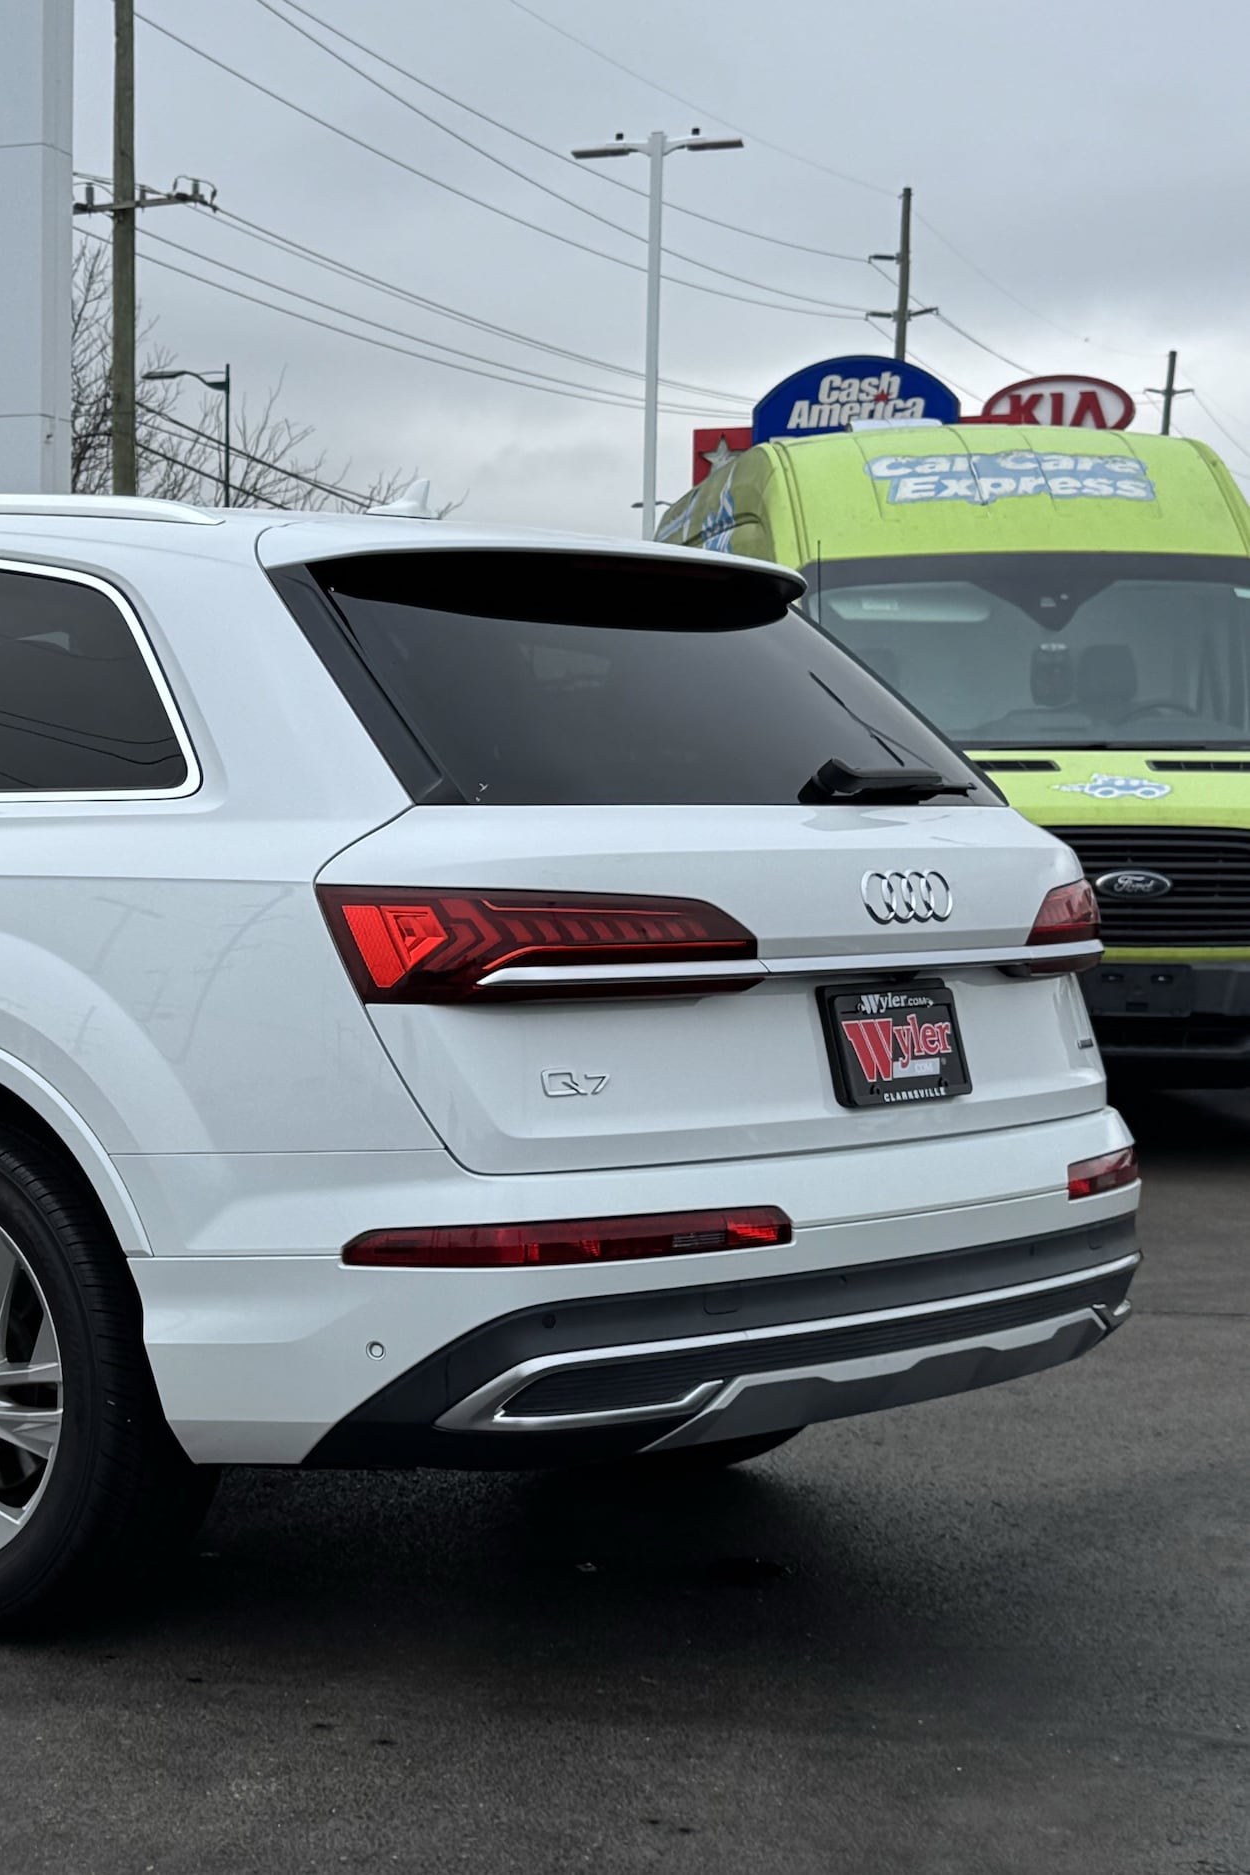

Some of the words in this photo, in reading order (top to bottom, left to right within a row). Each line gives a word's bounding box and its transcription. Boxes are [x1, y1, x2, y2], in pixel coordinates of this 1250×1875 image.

[818, 371, 901, 402] Cash
[786, 397, 926, 429] America
[1009, 391, 1108, 429] KIA
[871, 455, 979, 476] Car
[1002, 451, 1143, 474] Care
[895, 475, 1150, 503] Express
[1114, 875, 1155, 892] Ford
[841, 1014, 953, 1083] Wyler
[540, 1067, 610, 1098] Q7
[883, 1086, 947, 1103] CLARKSVILLE
